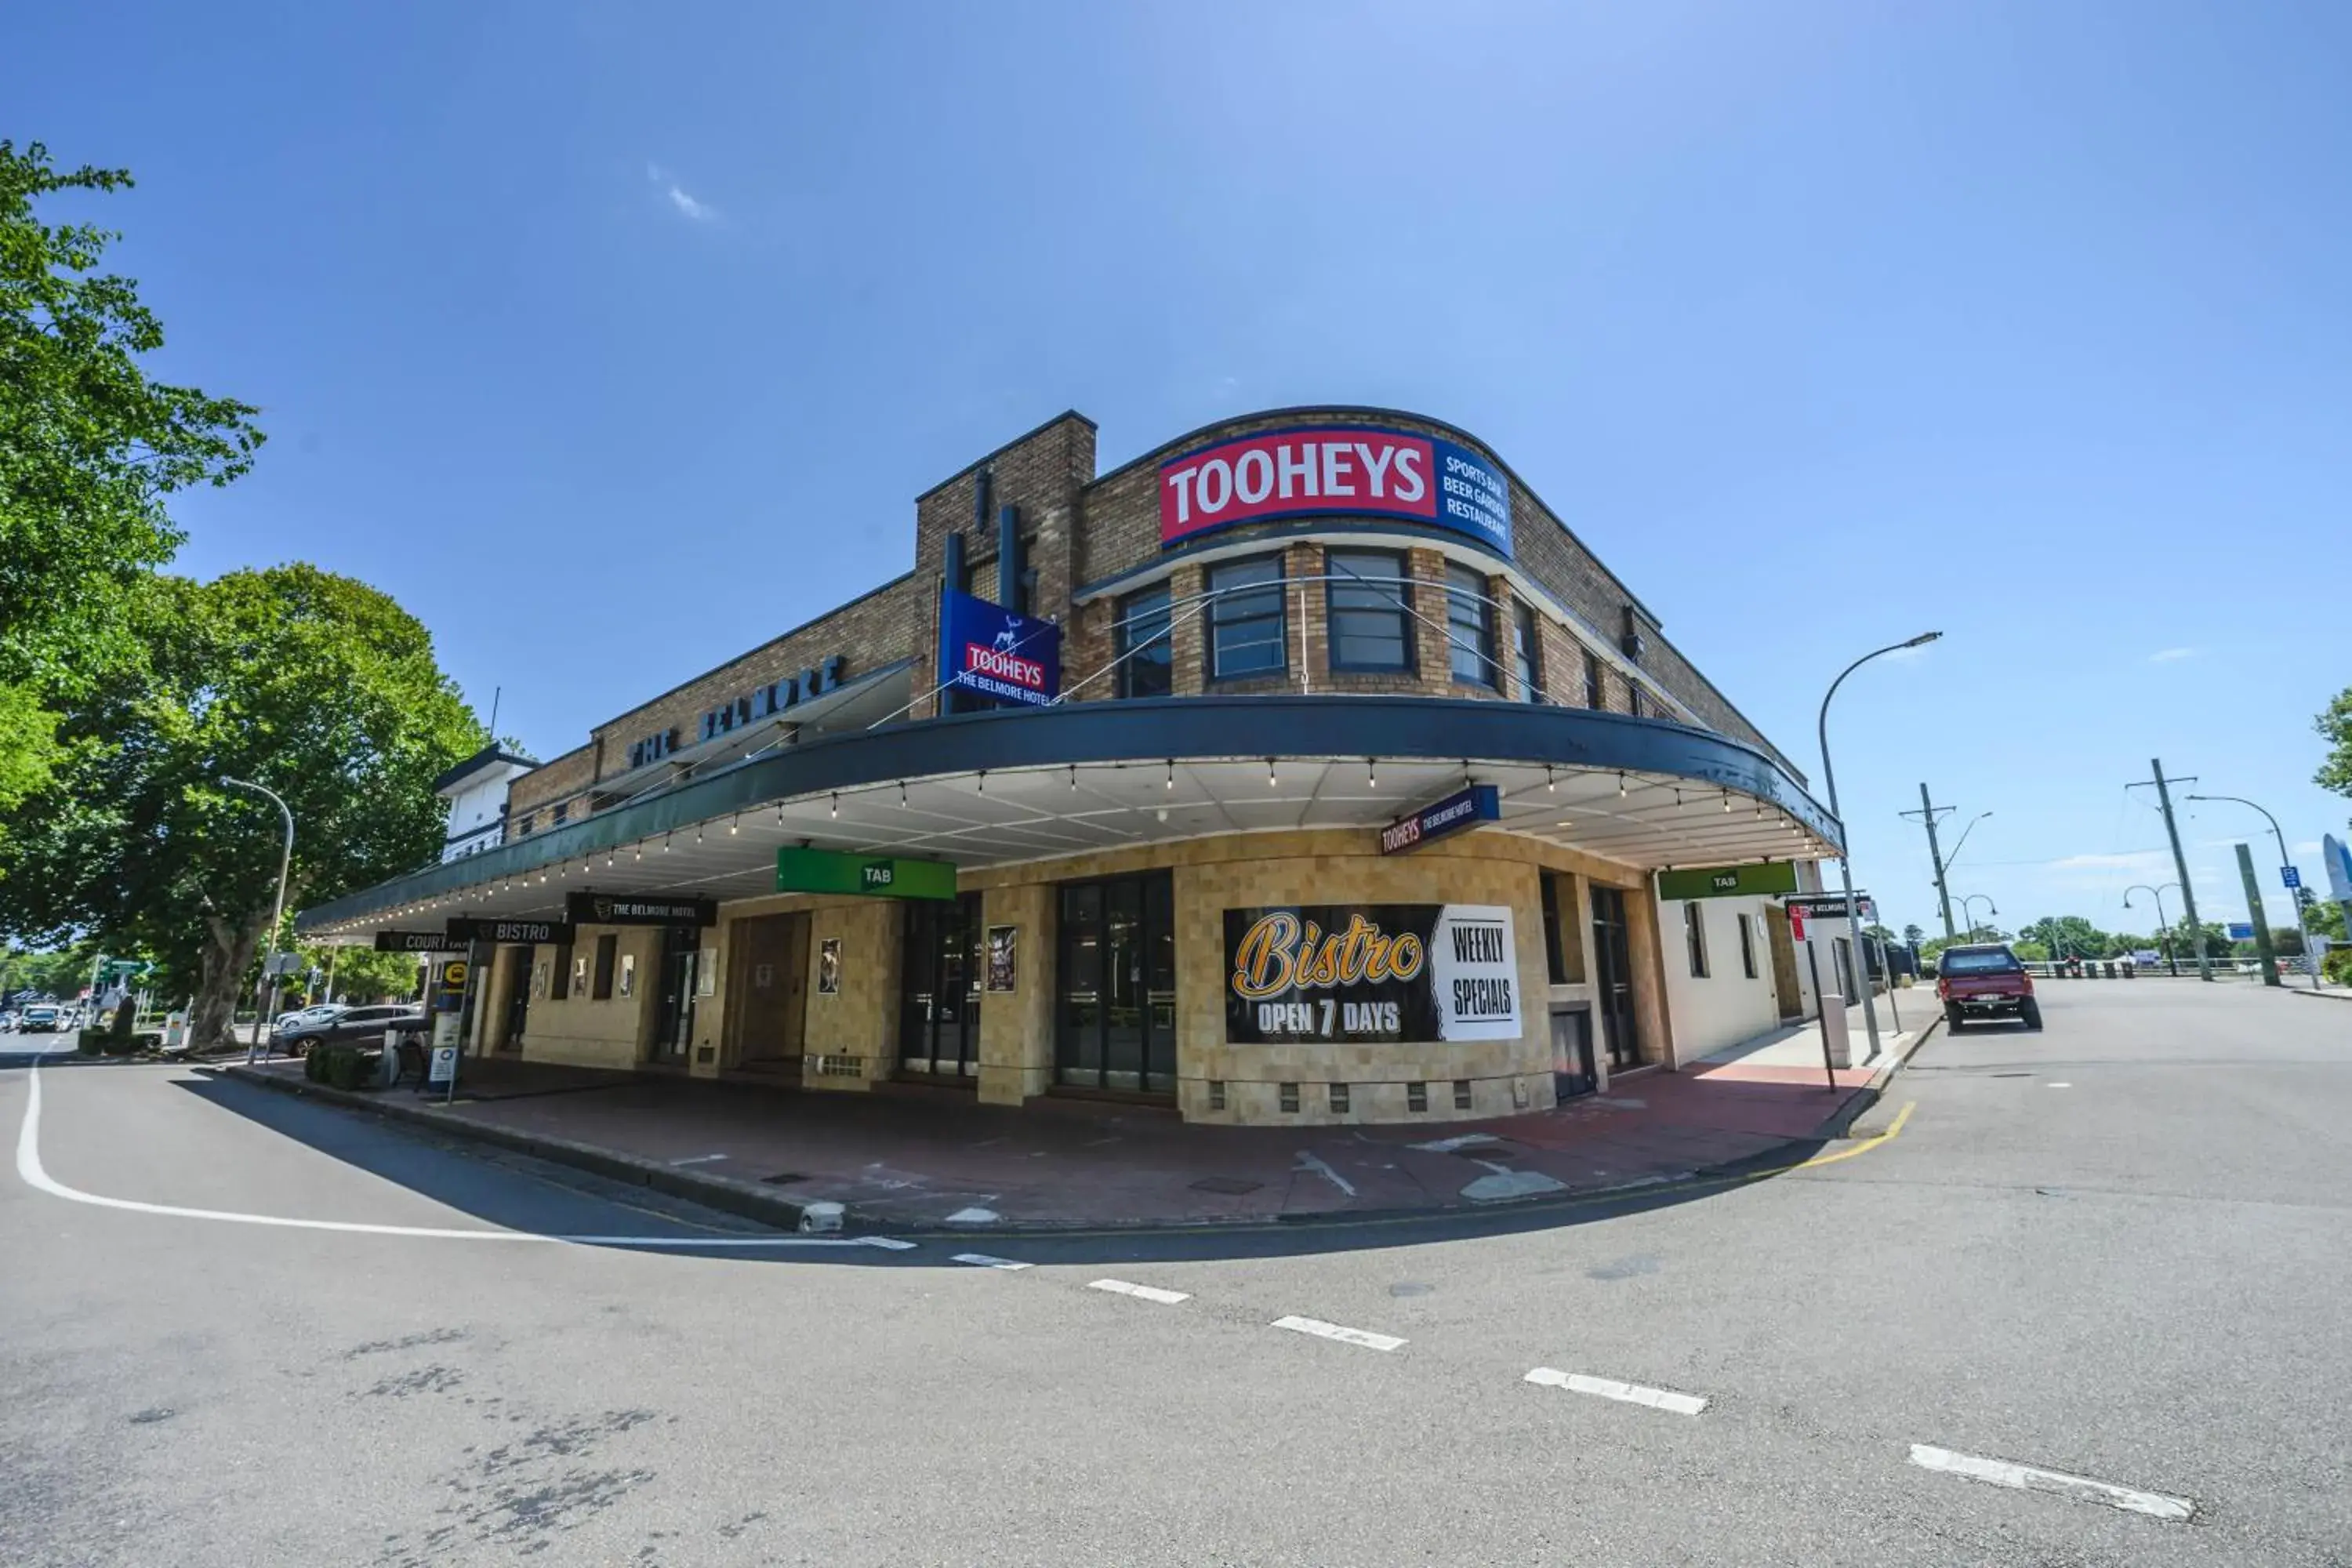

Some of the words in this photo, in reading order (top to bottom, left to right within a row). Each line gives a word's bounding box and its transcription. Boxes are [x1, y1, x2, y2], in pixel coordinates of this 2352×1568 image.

[1169, 443, 1425, 524] TOOHEYS
[1446, 456, 1486, 487] SPORTS
[1443, 476, 1474, 500] BEER
[1474, 488, 1506, 522] GARDEN
[1446, 498, 1506, 540] RESTAURANT
[970, 647, 1042, 686] TOOHEYS
[698, 655, 840, 742] BELMORE
[956, 670, 976, 688] THE
[978, 676, 1025, 701] BELMORE
[1023, 688, 1050, 706] HOTEL
[1423, 815, 1433, 831] THE
[1432, 807, 1456, 828] BELMORE
[1455, 800, 1474, 817] HOTEL
[1382, 817, 1420, 852] TOOHEYS
[865, 868, 891, 883] TAB
[1713, 877, 1737, 887] TAB
[614, 903, 630, 916] THE
[631, 903, 670, 917] BELMORE
[496, 924, 550, 941] BISTRO
[1451, 926, 1504, 964] WEEKLY
[1232, 911, 1424, 1002] Bistro
[1453, 978, 1512, 1015] SPECIALS
[1258, 1002, 1315, 1034] OPEN
[1319, 998, 1337, 1038] 7
[1343, 1002, 1401, 1034] DAYS
